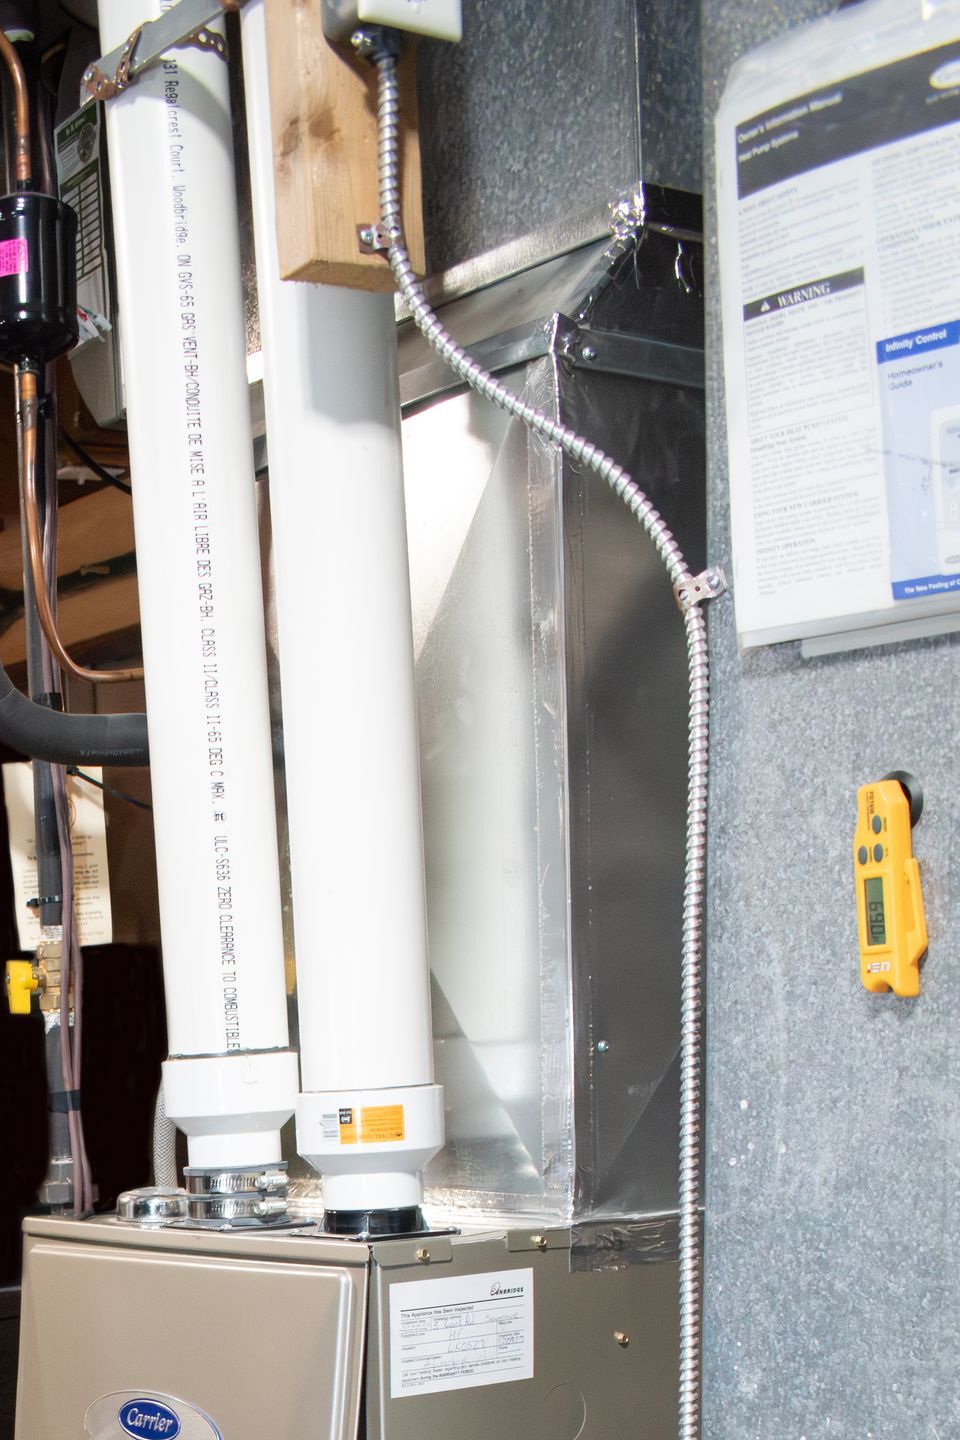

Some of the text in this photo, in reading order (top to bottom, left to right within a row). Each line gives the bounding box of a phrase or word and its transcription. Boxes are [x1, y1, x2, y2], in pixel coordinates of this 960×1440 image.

[164, 80, 181, 138] Regalcrest
[176, 254, 191, 267] ON
[178, 272, 194, 307] GVS-65
[777, 282, 831, 308] WARNING
[181, 312, 196, 330] GAS
[885, 328, 948, 352] Infinity Control
[182, 336, 201, 428] VENT-BH/CONDUITE
[888, 380, 913, 391] Guide
[188, 434, 202, 446] DE
[189, 451, 204, 474] MISE
[194, 526, 210, 555] LIBRE
[196, 560, 211, 576] DES
[201, 628, 216, 658] CLASS
[203, 664, 219, 708] II/CLASS
[206, 715, 222, 742] II-65
[208, 748, 222, 765] DEG
[214, 836, 230, 880] ULC-S636
[217, 886, 232, 910] ZERO
[219, 914, 236, 965] CLEARANCE
[222, 971, 236, 982] TO
[126, 1407, 174, 1434] Carrier
